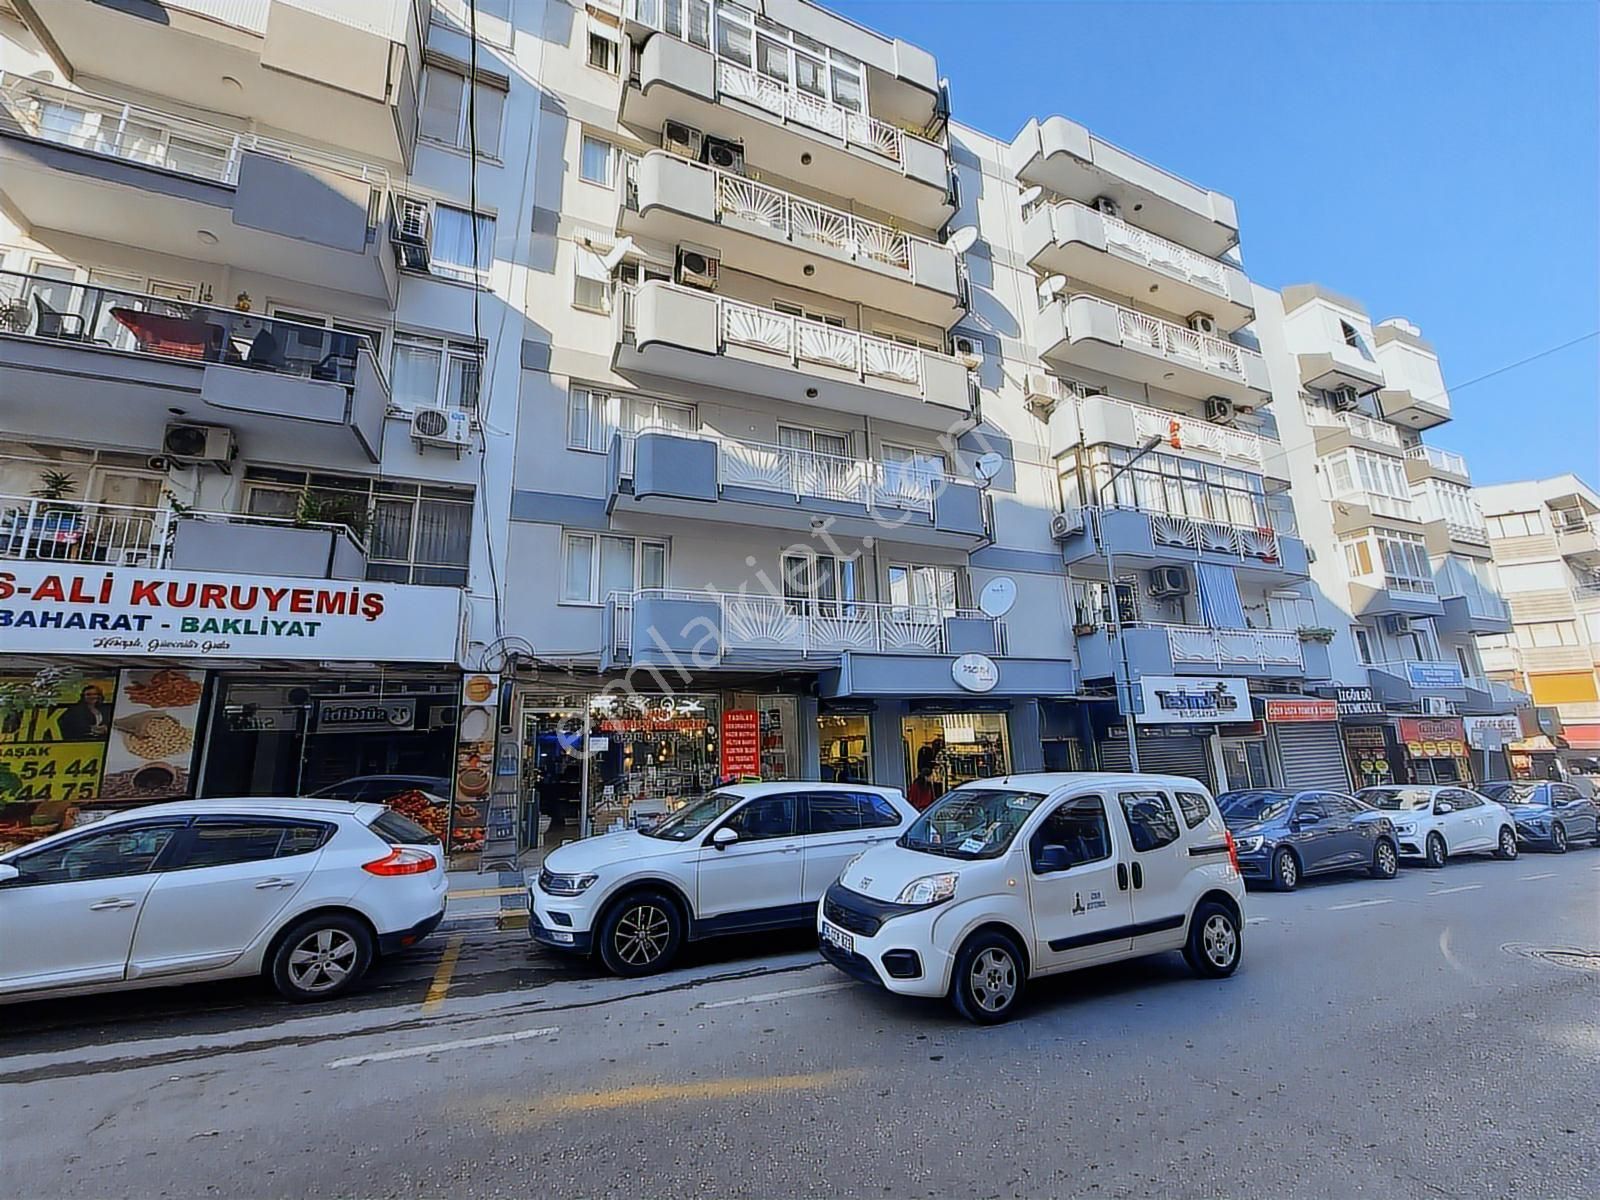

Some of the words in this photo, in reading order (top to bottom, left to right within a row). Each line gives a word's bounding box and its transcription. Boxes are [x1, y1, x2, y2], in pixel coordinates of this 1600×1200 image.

[130, 580, 384, 621] KURUYEMİŞ
[0, 609, 152, 632] BAHARAT
[181, 616, 321, 637] BAKLİYAT
[20, 761, 57, 780] 54
[64, 758, 98, 778] 44
